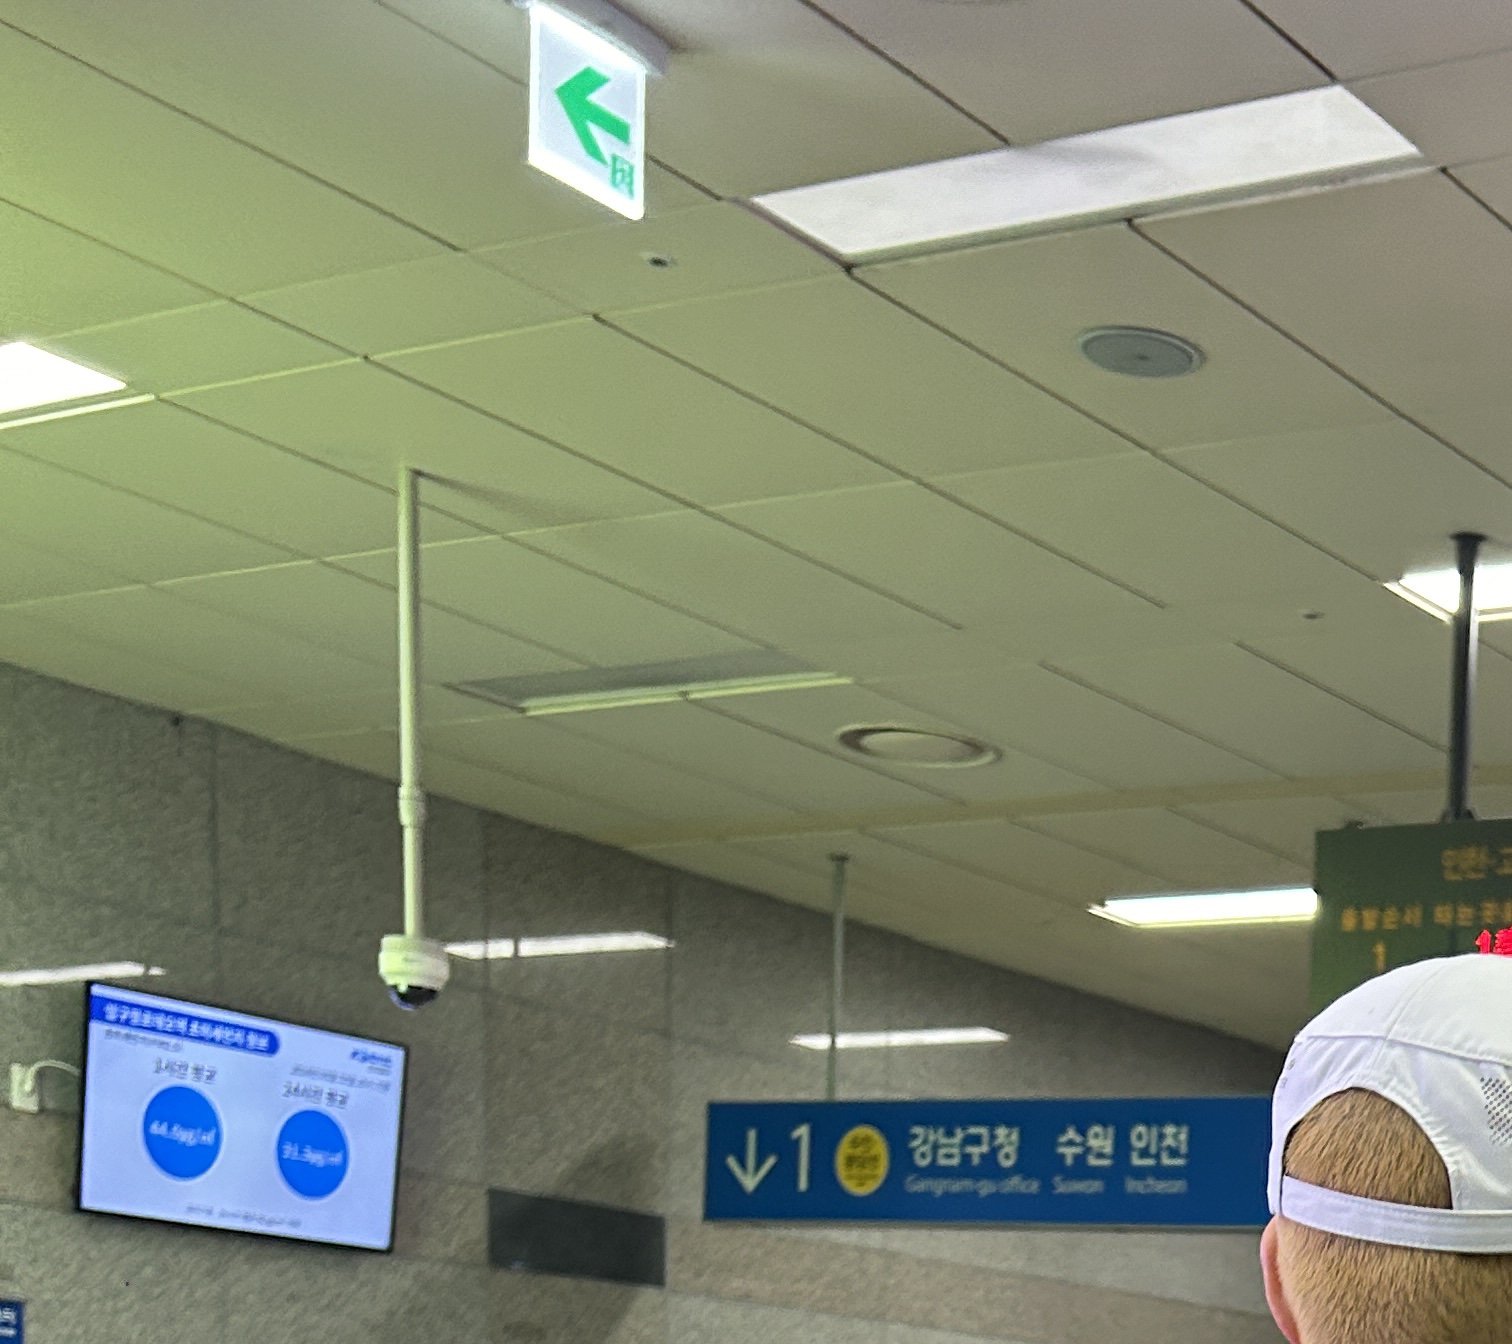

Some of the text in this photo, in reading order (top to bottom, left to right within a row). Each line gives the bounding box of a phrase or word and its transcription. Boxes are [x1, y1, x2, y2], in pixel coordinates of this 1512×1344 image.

[789, 1122, 1189, 1193] 1 강남구청 수원 인천
